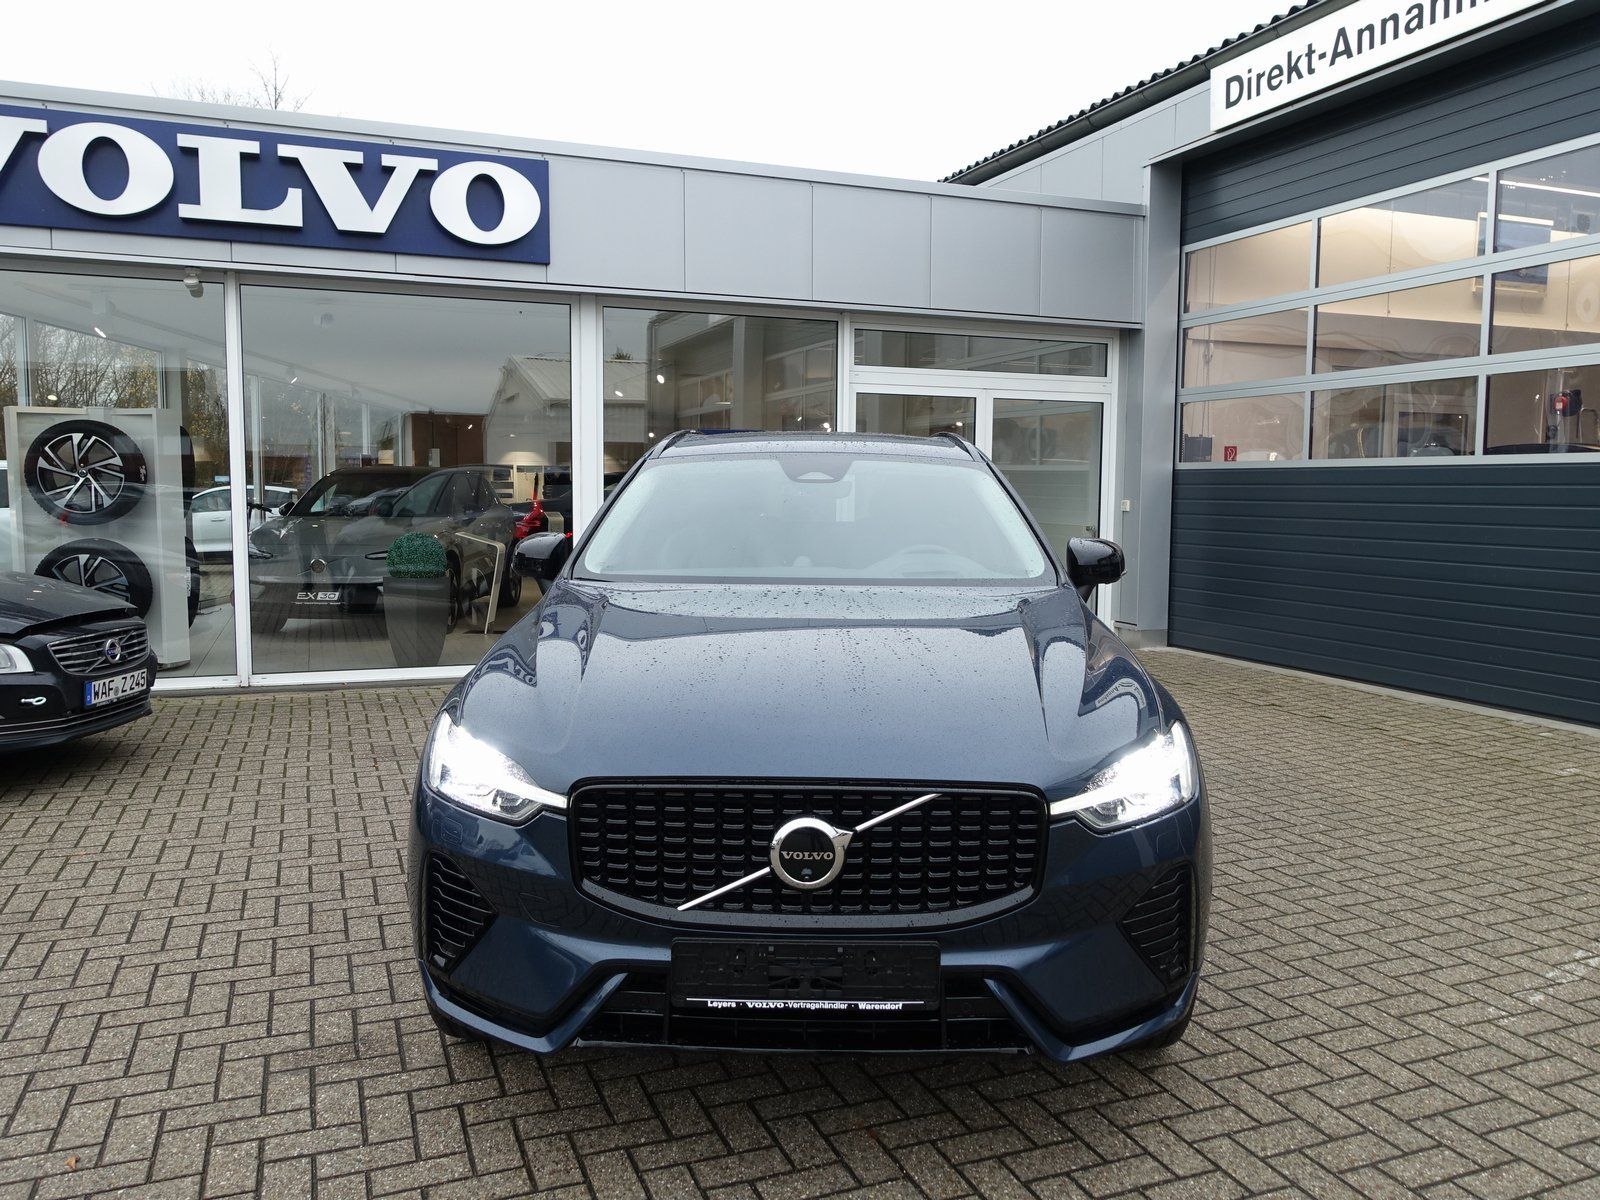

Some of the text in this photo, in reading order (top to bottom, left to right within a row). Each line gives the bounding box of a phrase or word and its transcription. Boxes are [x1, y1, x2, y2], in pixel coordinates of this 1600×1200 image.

[1225, 0, 1490, 110] Direkt-Annah
[0, 115, 541, 246] OLVO
[93, 671, 146, 700] WAF Z 245
[781, 851, 834, 860] VOLVO
[707, 1000, 736, 1009] Leyers
[858, 1002, 903, 1010] Warendorf
